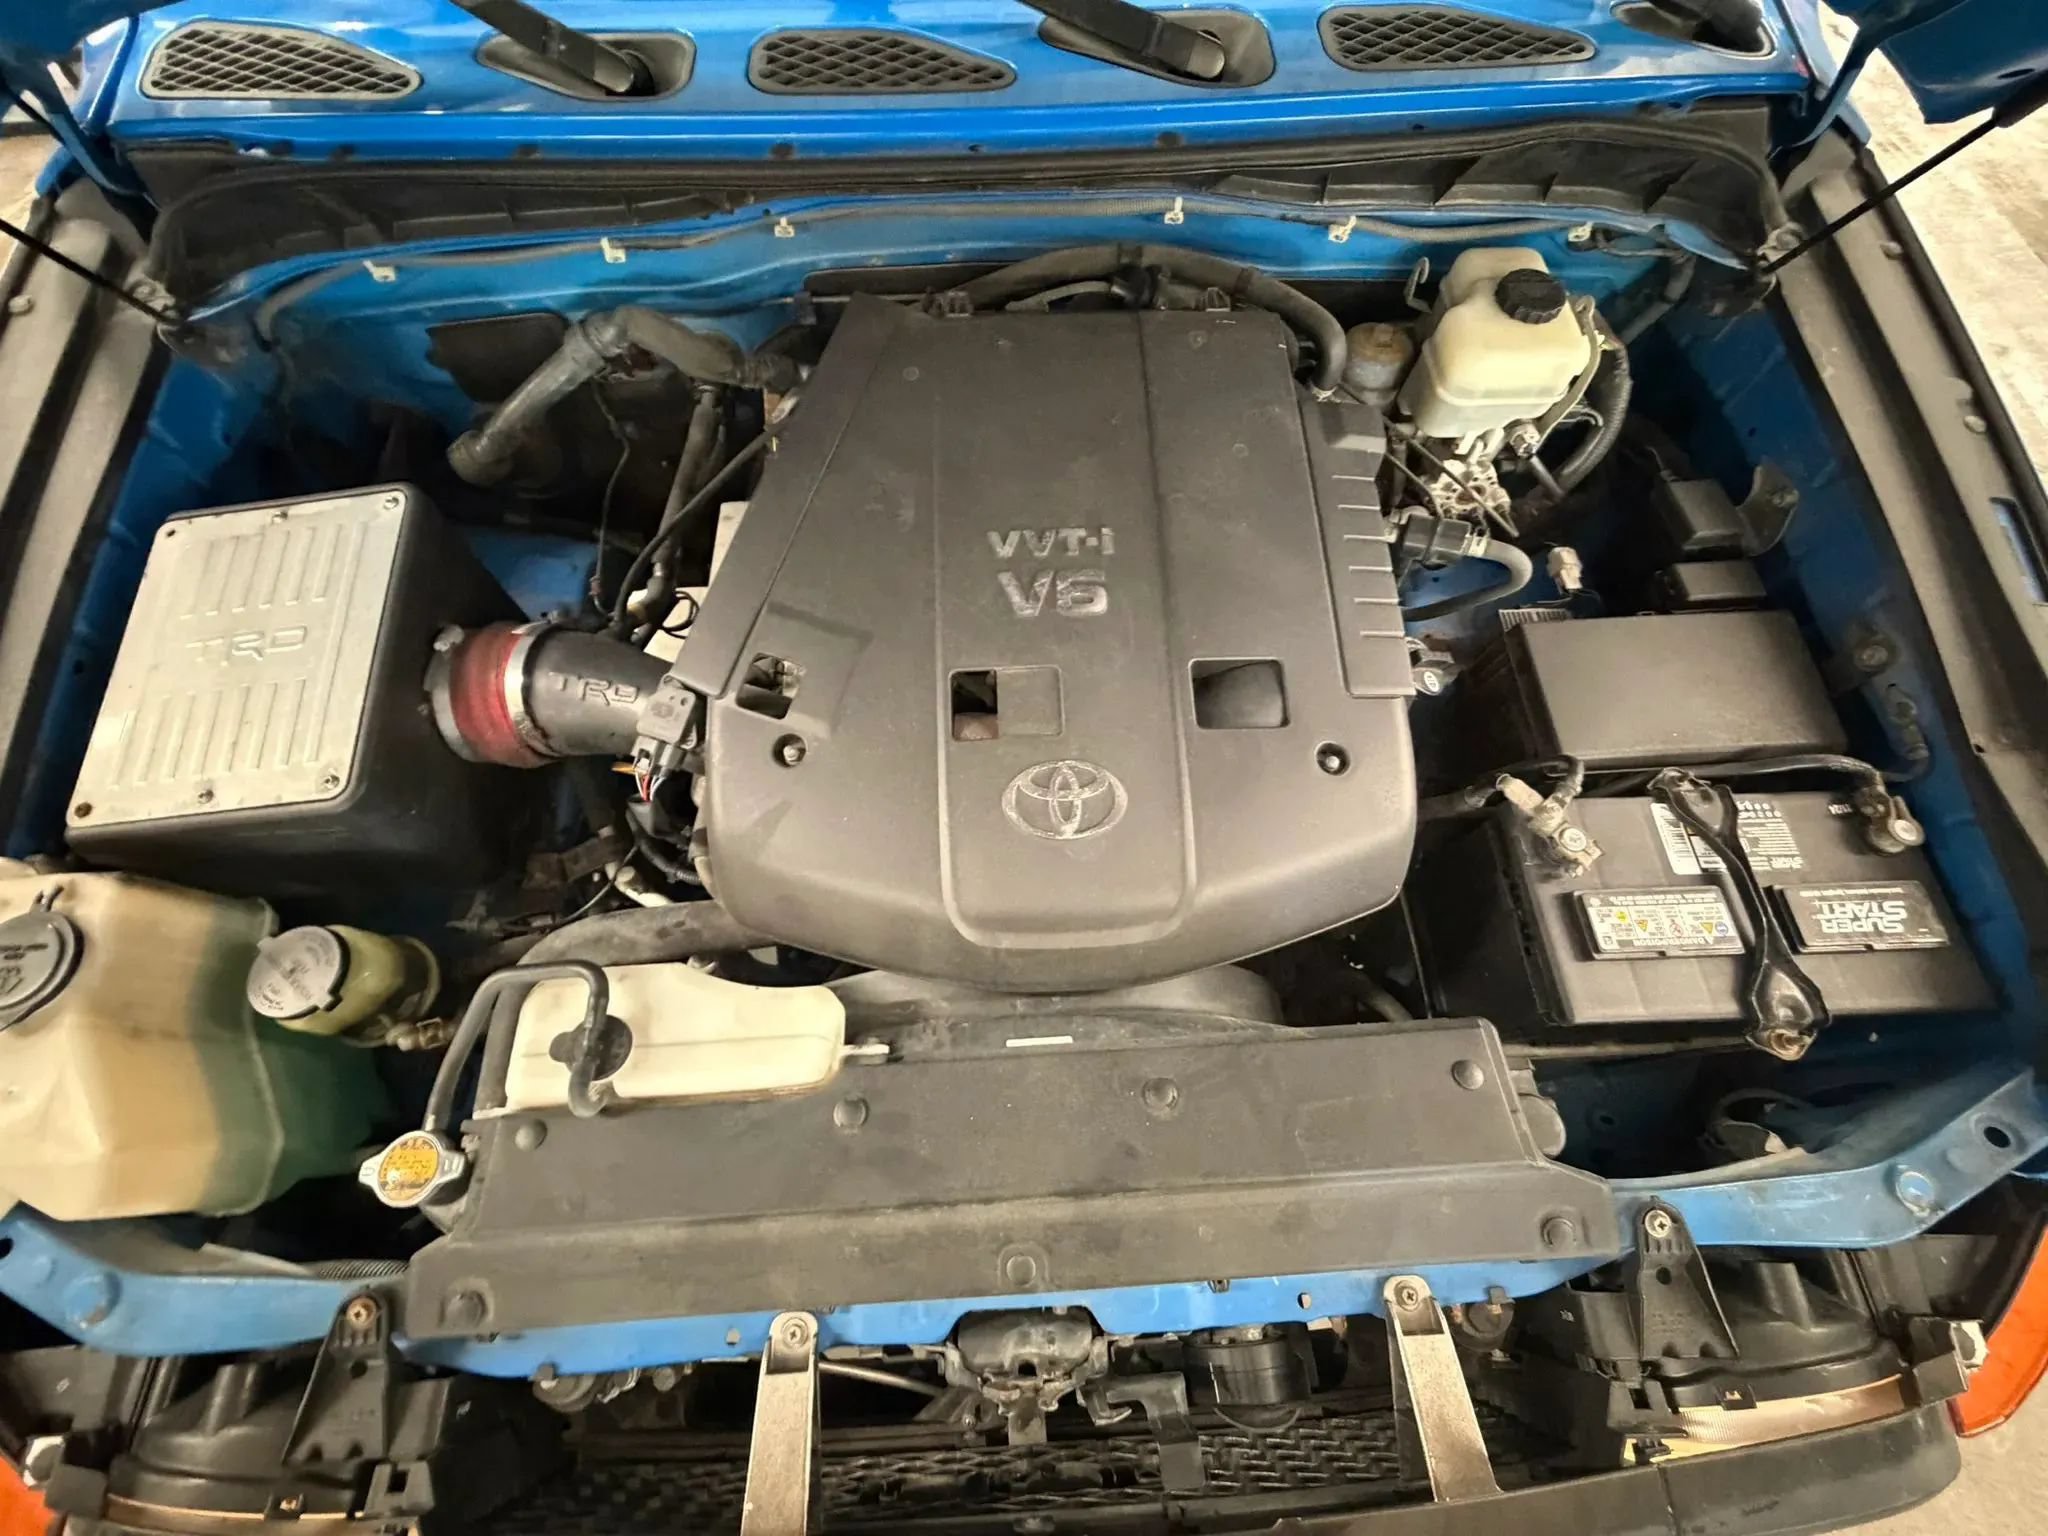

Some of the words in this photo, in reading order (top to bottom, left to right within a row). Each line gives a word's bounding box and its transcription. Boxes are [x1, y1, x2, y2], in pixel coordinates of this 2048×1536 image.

[986, 527, 1115, 559] VVT-i
[997, 570, 1108, 617] V6
[184, 624, 307, 666] TRD
[548, 671, 640, 706] TRD
[1812, 900, 1908, 920] START
[1819, 918, 1905, 934] SUPER
